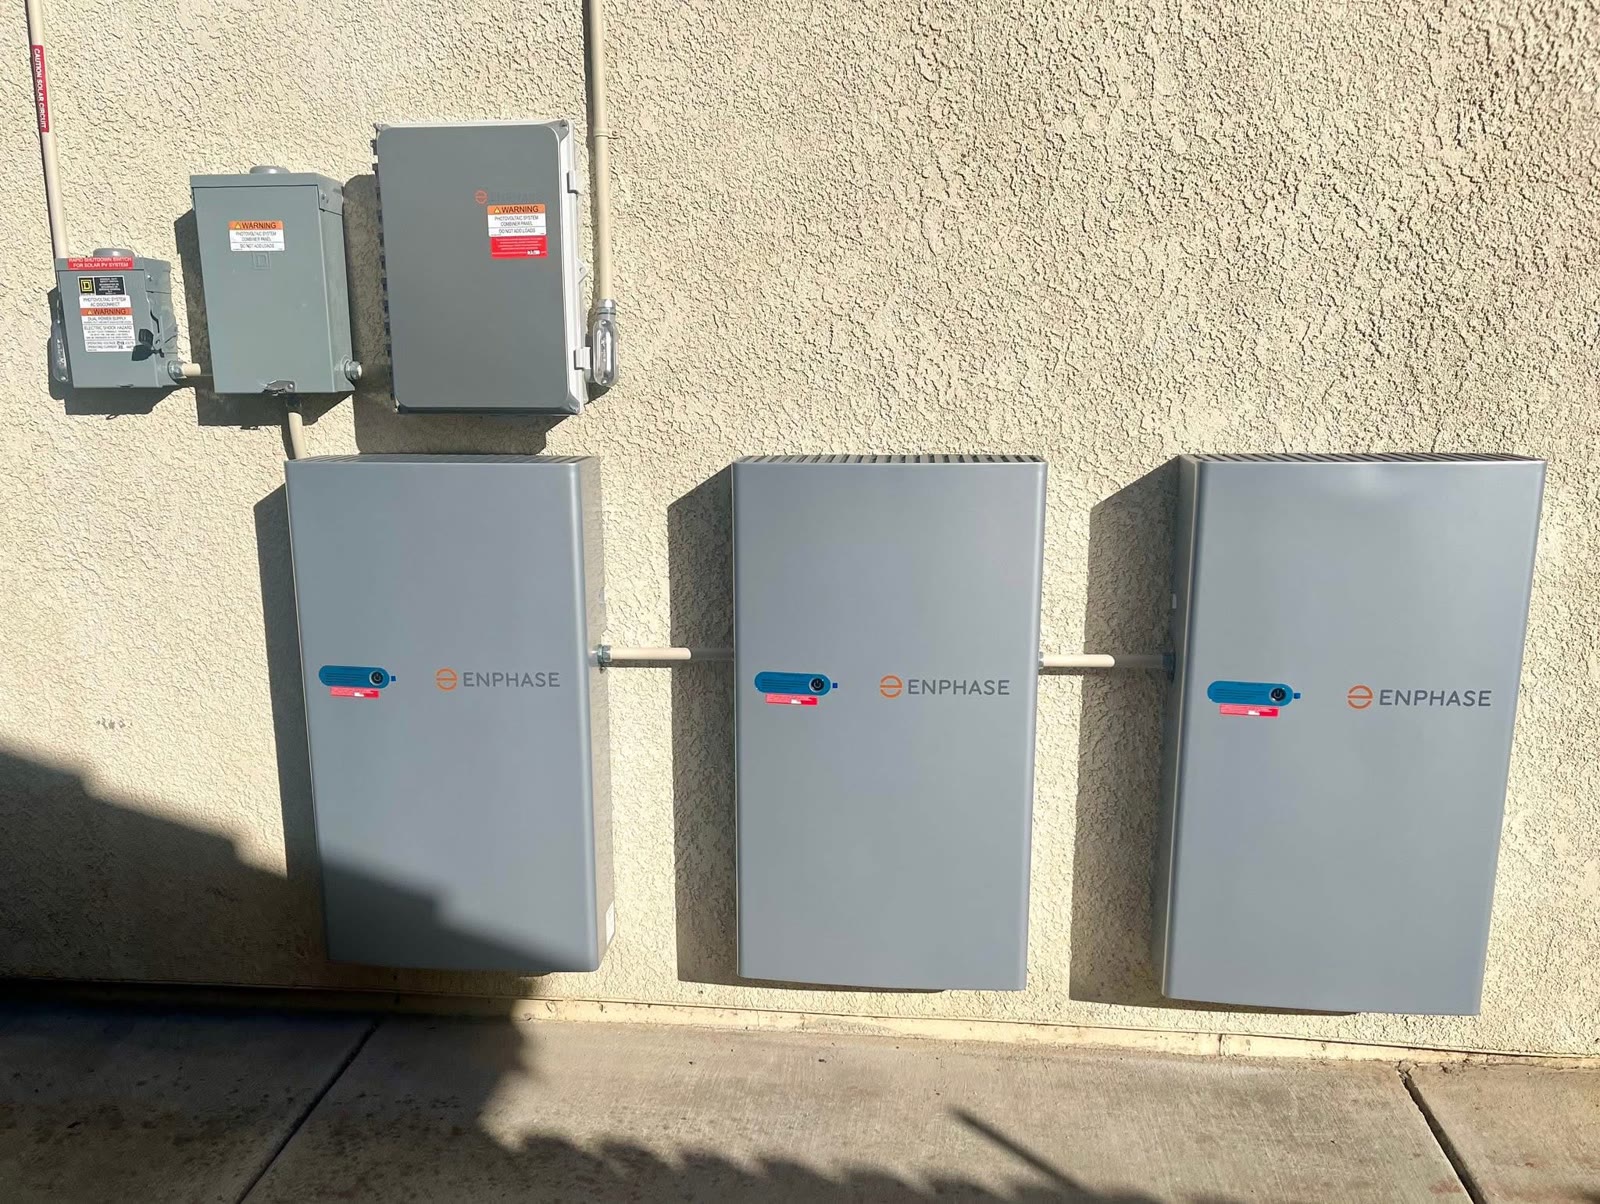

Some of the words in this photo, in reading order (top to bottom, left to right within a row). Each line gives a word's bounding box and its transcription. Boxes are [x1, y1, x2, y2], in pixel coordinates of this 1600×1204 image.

[38, 104, 46, 128] CIRCUIT
[464, 672, 560, 688] ENPHASE
[908, 679, 1010, 695] ENPHASE
[1380, 690, 1492, 707] ENPHASE
